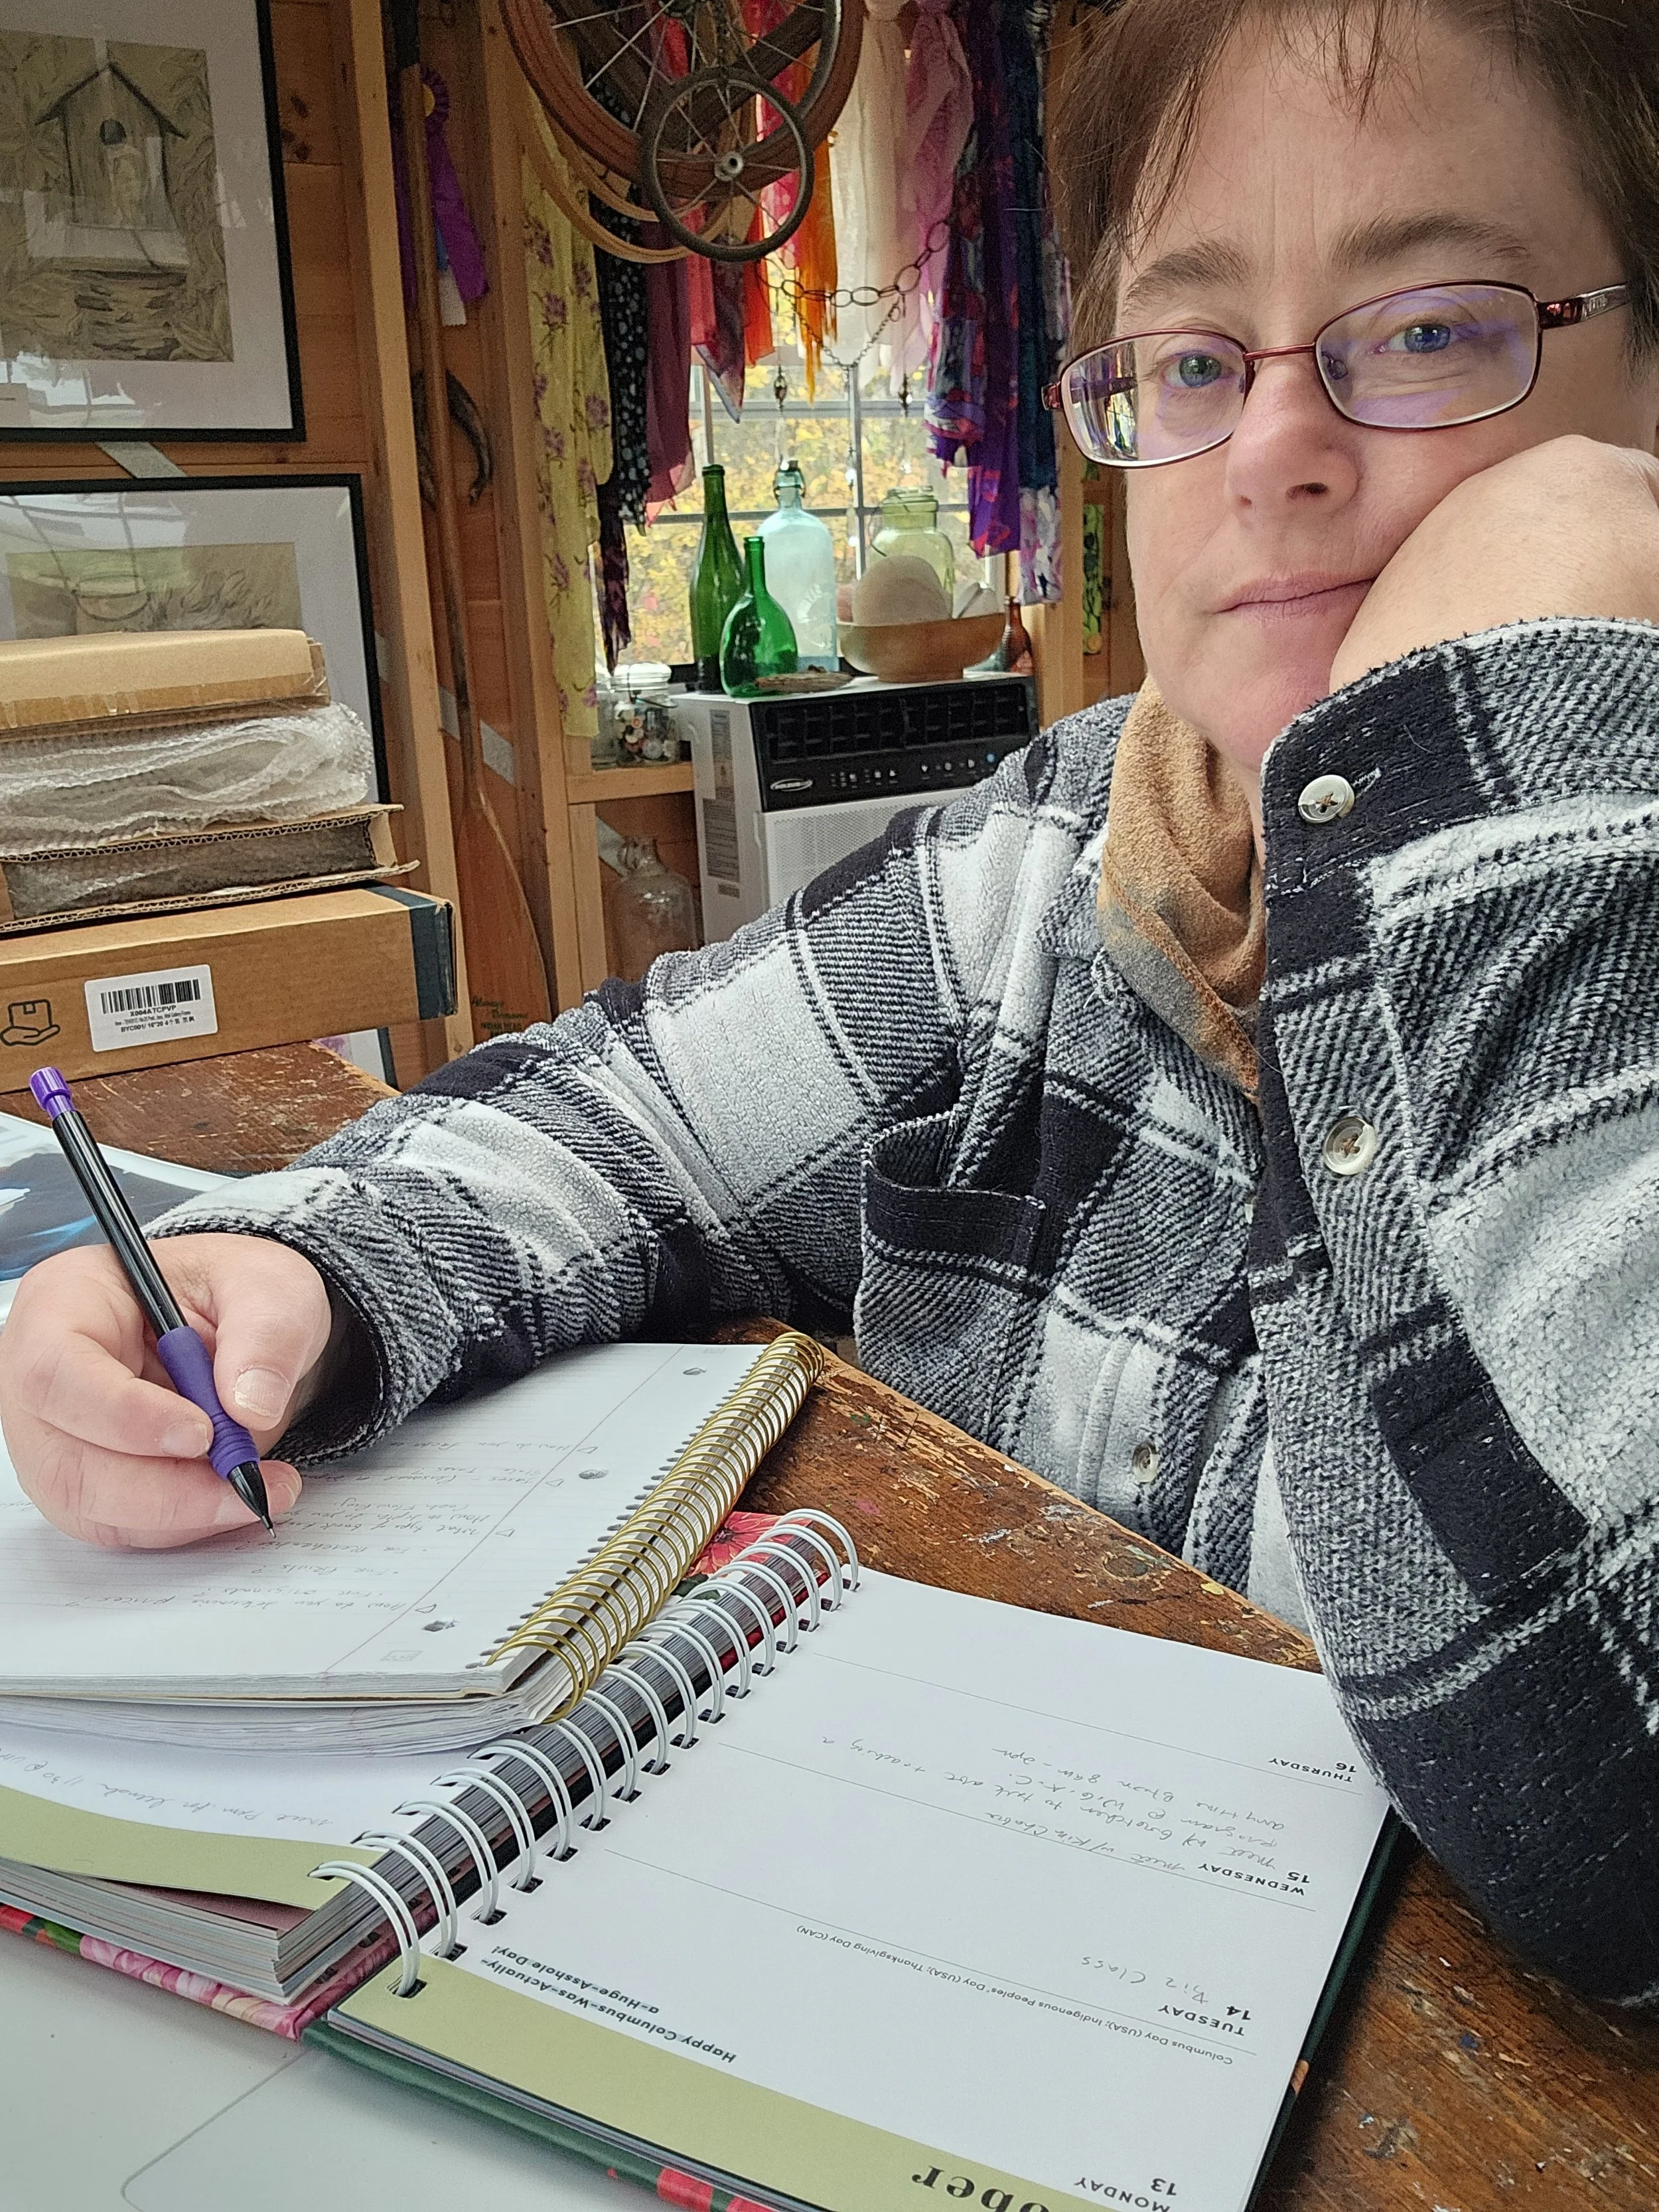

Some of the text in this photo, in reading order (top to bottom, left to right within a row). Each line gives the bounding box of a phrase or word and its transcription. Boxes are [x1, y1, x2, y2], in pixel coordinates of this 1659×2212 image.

[295, 1598, 329, 1607] you
[822, 1735, 835, 1745] a
[849, 1739, 925, 1773] teaching
[1267, 1757, 1353, 1783] THURSDAY
[1334, 1761, 1357, 1773] 16
[1045, 1799, 1062, 1810] to
[1147, 1808, 1165, 1820] @
[1054, 1828, 1090, 1847] Kim
[1197, 1862, 1305, 1896] WEDNESDAY
[1286, 1871, 1311, 1884] 15
[796, 1925, 829, 1942] (CAN)
[829, 1933, 852, 1949] Day
[852, 1942, 924, 1973] Thanksgiving
[925, 1965, 962, 1984] (USA);
[1080, 1956, 1147, 1984] Class
[490, 1945, 660, 2016] a-Huge-Asshole Day!
[962, 1977, 986, 1992] Day
[1037, 2000, 1103, 2027] Indigenous
[1157, 2004, 1245, 2036] TUESDAY
[1226, 2005, 1252, 2020] 14
[1104, 2019, 1143, 2038] (USA);
[1144, 2031, 1169, 2046] Day
[680, 2035, 737, 2064] Happy
[1171, 2039, 1234, 2066] Columbus
[1074, 2176, 1171, 2212] MONDAY
[1150, 2177, 1177, 2196] 13
